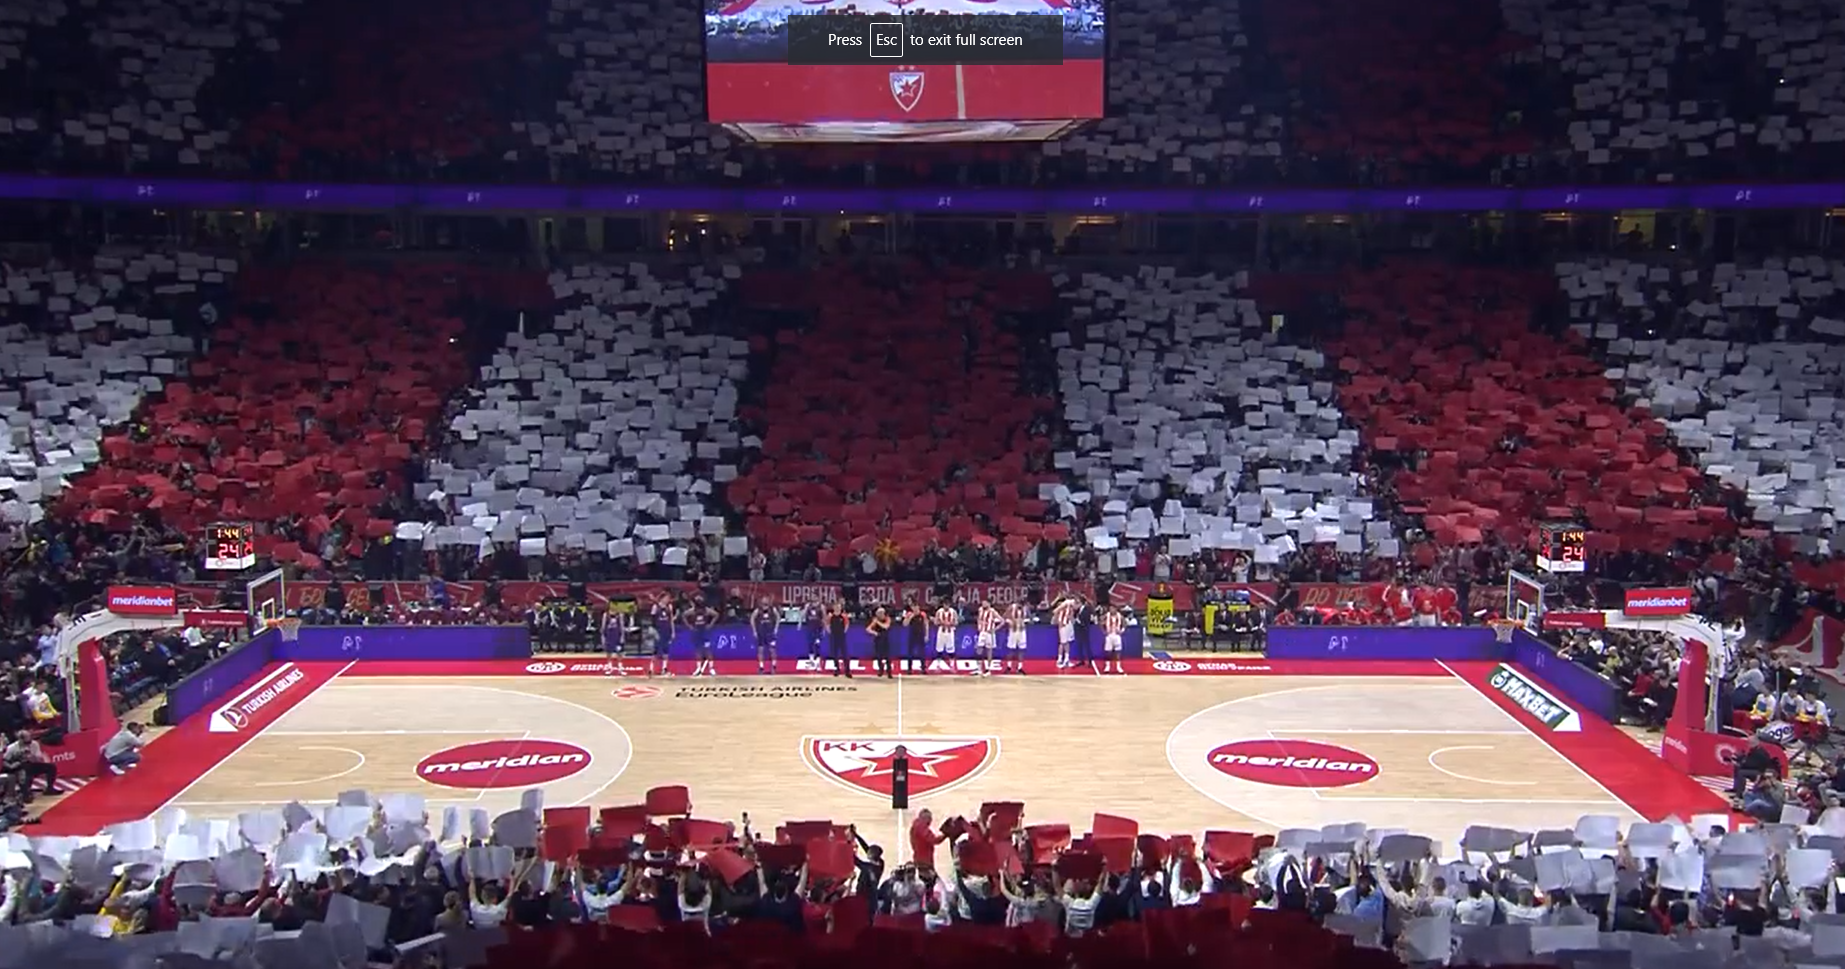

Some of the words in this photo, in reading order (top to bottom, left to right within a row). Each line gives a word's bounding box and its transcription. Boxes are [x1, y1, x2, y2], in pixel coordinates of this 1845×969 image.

[217, 528, 240, 539] 1:44
[1562, 531, 1584, 542] 1:44
[218, 543, 240, 560] 24
[1562, 546, 1585, 563] 24
[112, 595, 173, 607] meridianbet
[1627, 597, 1687, 608] meridianbet
[241, 687, 277, 714] TURKISH
[272, 668, 304, 694] AIRLINES
[675, 691, 813, 699] EuroLeague
[1501, 676, 1564, 724] MAXBET
[823, 742, 875, 752] KK
[52, 751, 76, 763] mts
[1212, 753, 1373, 773] meridian
[423, 754, 584, 775] meridian
